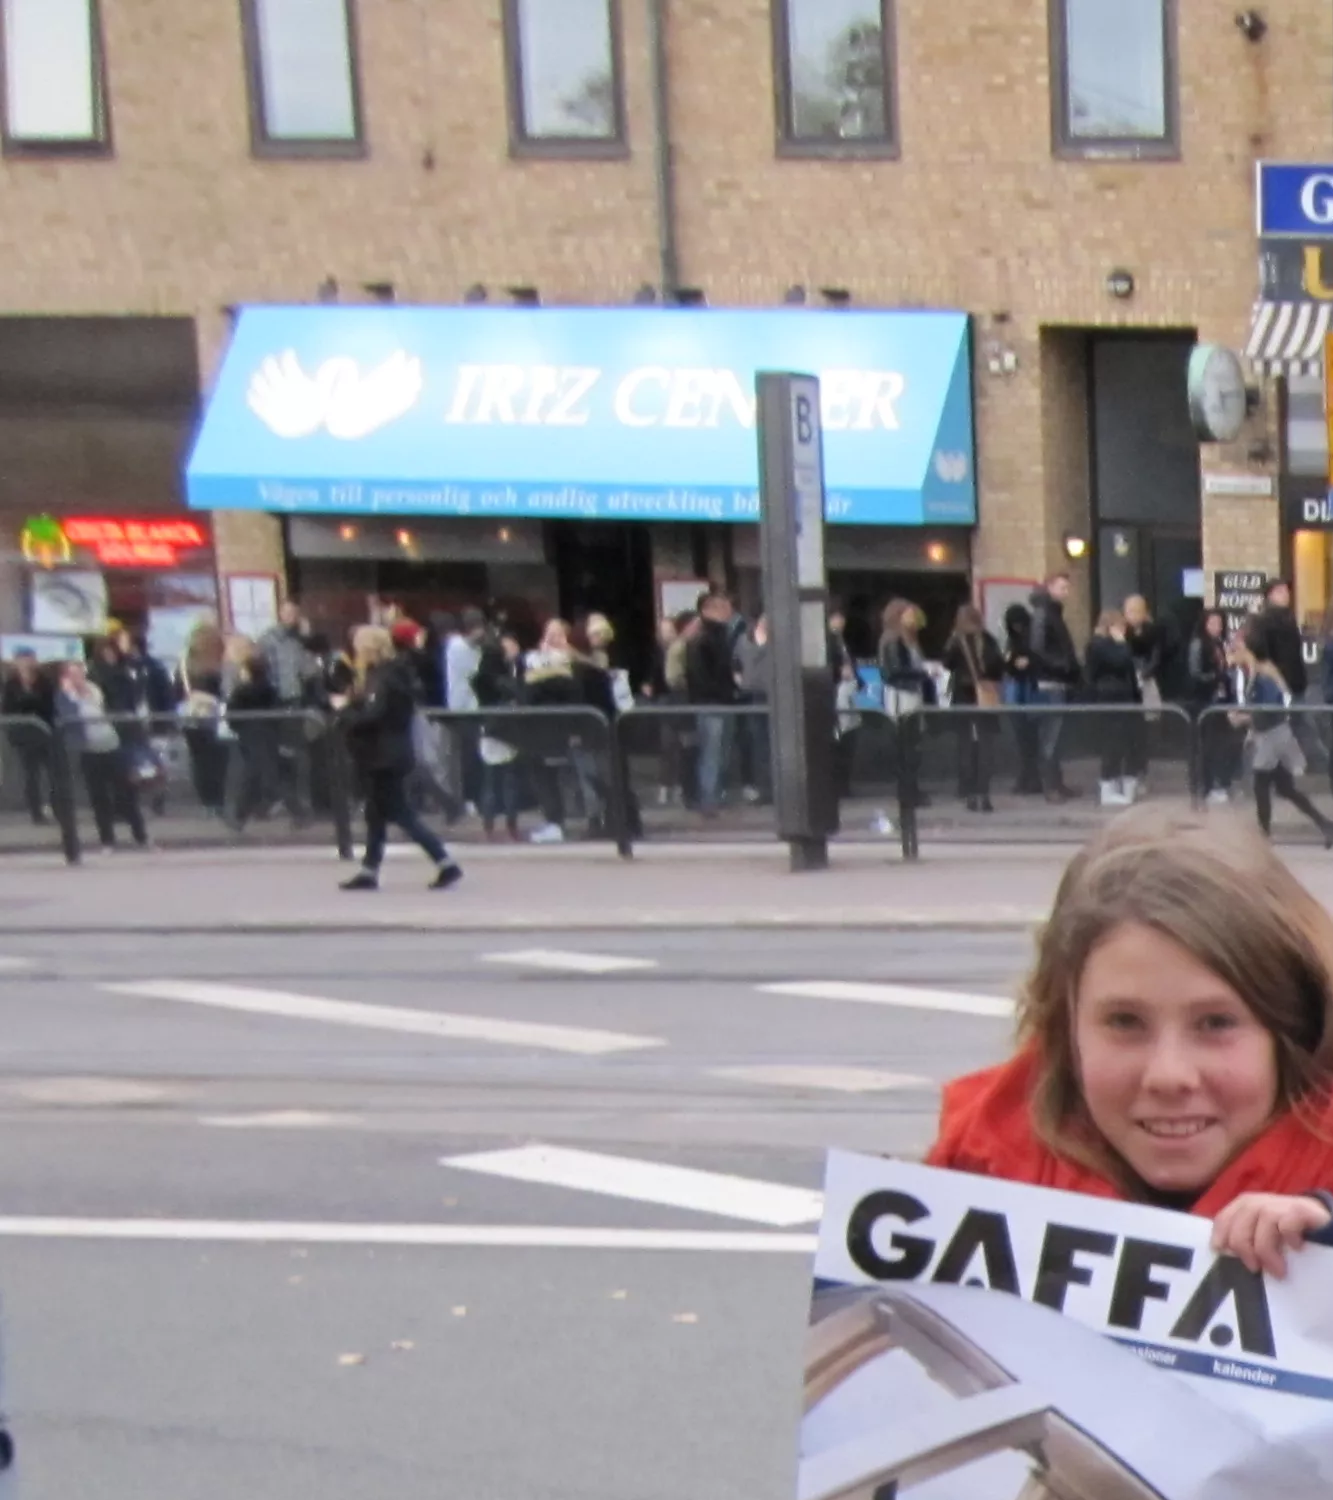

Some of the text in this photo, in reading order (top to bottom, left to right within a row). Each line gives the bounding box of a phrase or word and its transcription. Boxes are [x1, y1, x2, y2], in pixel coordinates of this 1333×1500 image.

[444, 364, 904, 430] IRIZ CENER
[331, 484, 363, 503] till
[371, 485, 471, 514] personlig
[481, 487, 518, 507] och
[527, 487, 599, 517] andlig
[607, 489, 723, 517] utveckling
[1223, 574, 1262, 590] GULD
[845, 1188, 1277, 1359] GAFFA
[1212, 1359, 1277, 1387] kalender
